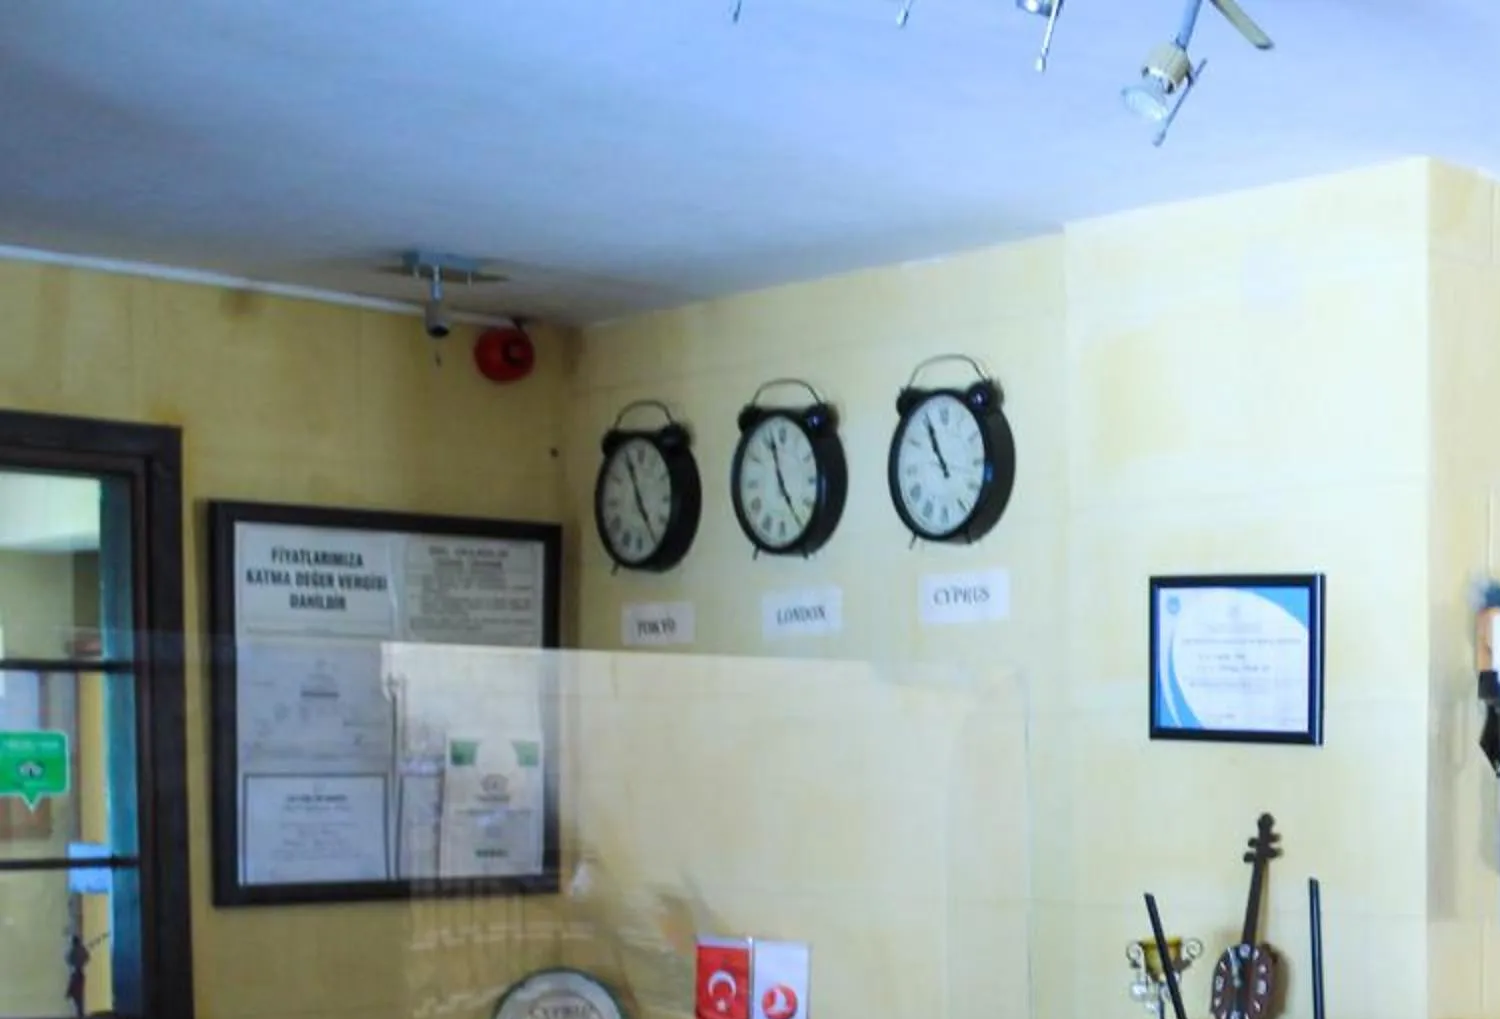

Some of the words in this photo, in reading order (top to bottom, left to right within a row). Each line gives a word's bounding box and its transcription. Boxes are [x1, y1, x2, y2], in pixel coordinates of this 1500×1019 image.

[245, 568, 291, 586] KATMA
[933, 584, 990, 604] CYPRUS
[776, 604, 826, 626] LONDON
